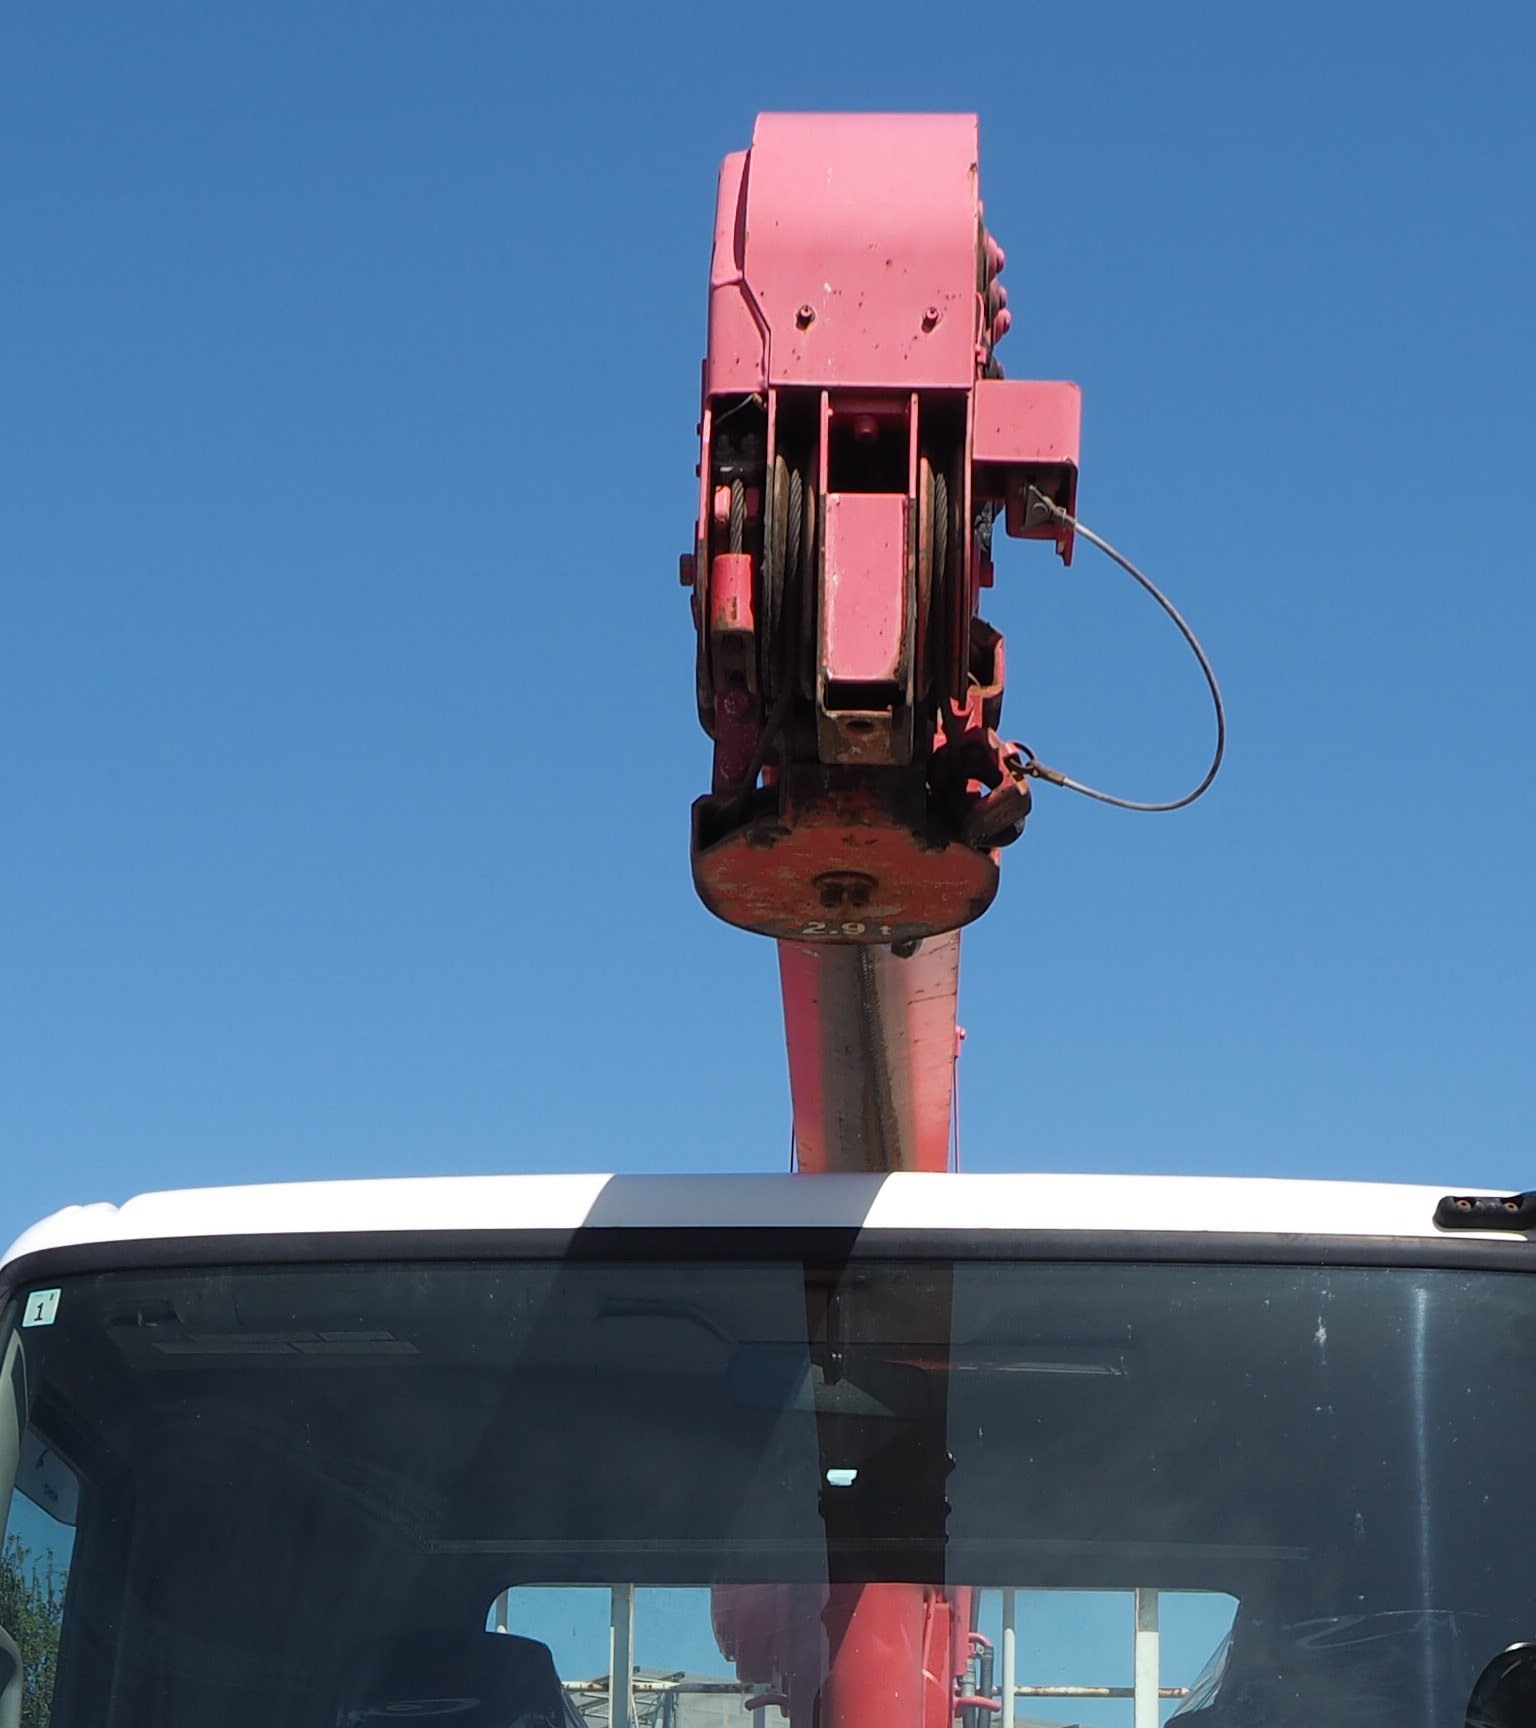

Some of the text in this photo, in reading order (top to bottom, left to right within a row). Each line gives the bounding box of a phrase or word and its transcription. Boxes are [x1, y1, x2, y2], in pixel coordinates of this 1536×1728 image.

[801, 920, 891, 936] 2.9 t
[34, 1302, 44, 1322] 1
